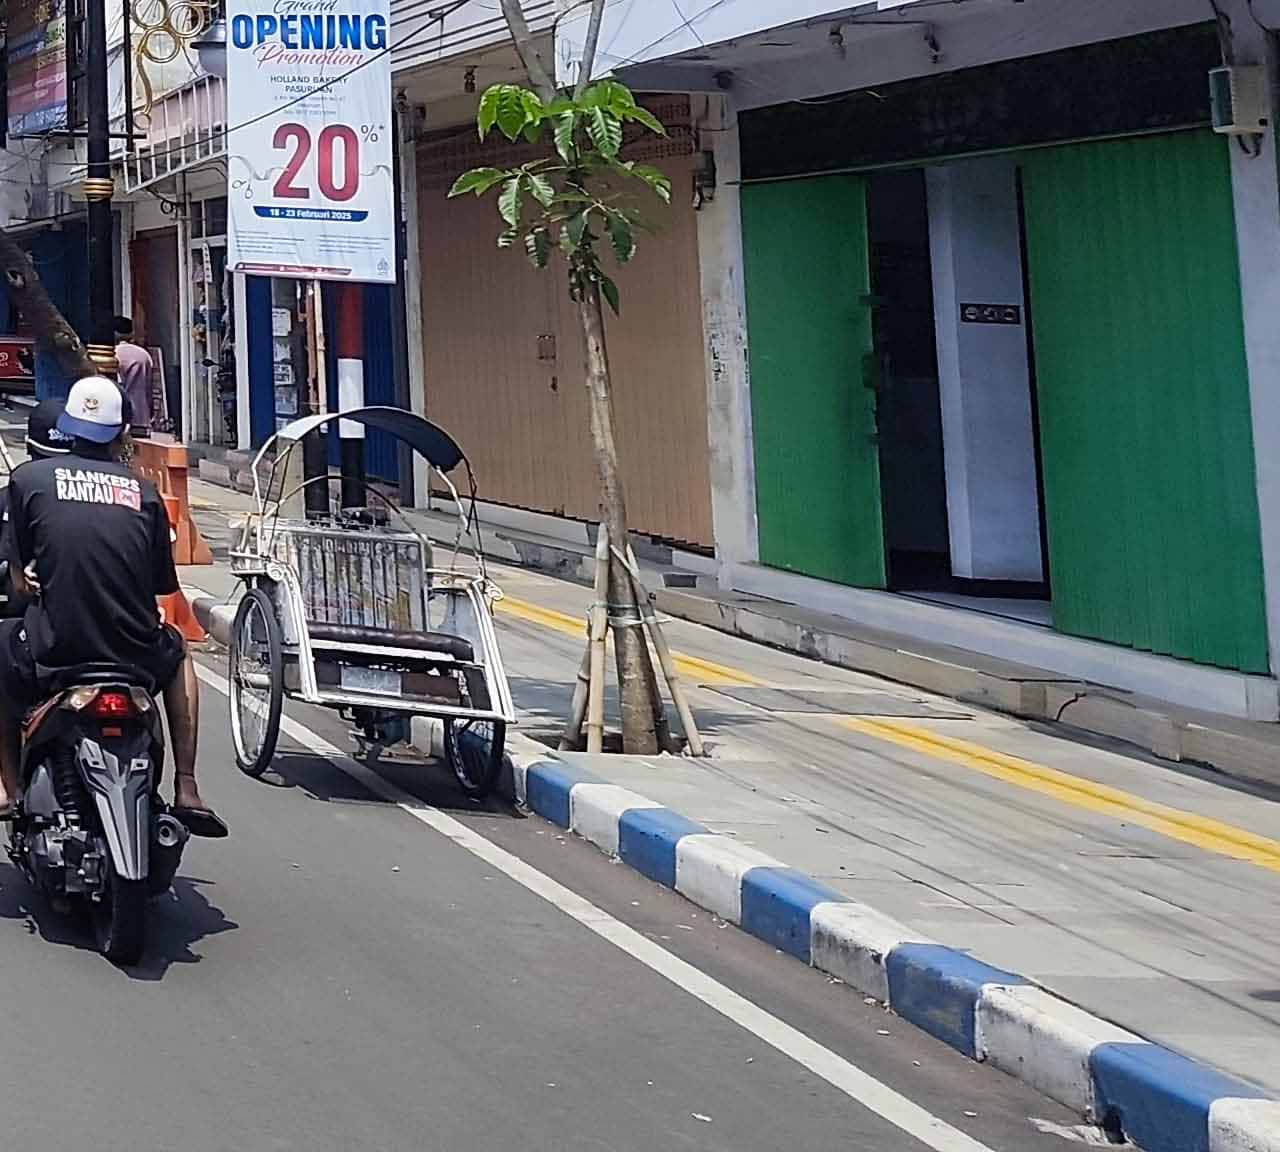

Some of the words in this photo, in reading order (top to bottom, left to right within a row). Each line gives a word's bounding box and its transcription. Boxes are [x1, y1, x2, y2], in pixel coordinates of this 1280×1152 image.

[231, 13, 388, 50] OPENING
[252, 40, 365, 70] Promotion
[270, 75, 310, 84] HOLLAND
[312, 76, 348, 84] BAKERY
[272, 122, 360, 202] 20
[54, 467, 140, 493] SLANKERS
[56, 481, 114, 504] RANTAU
